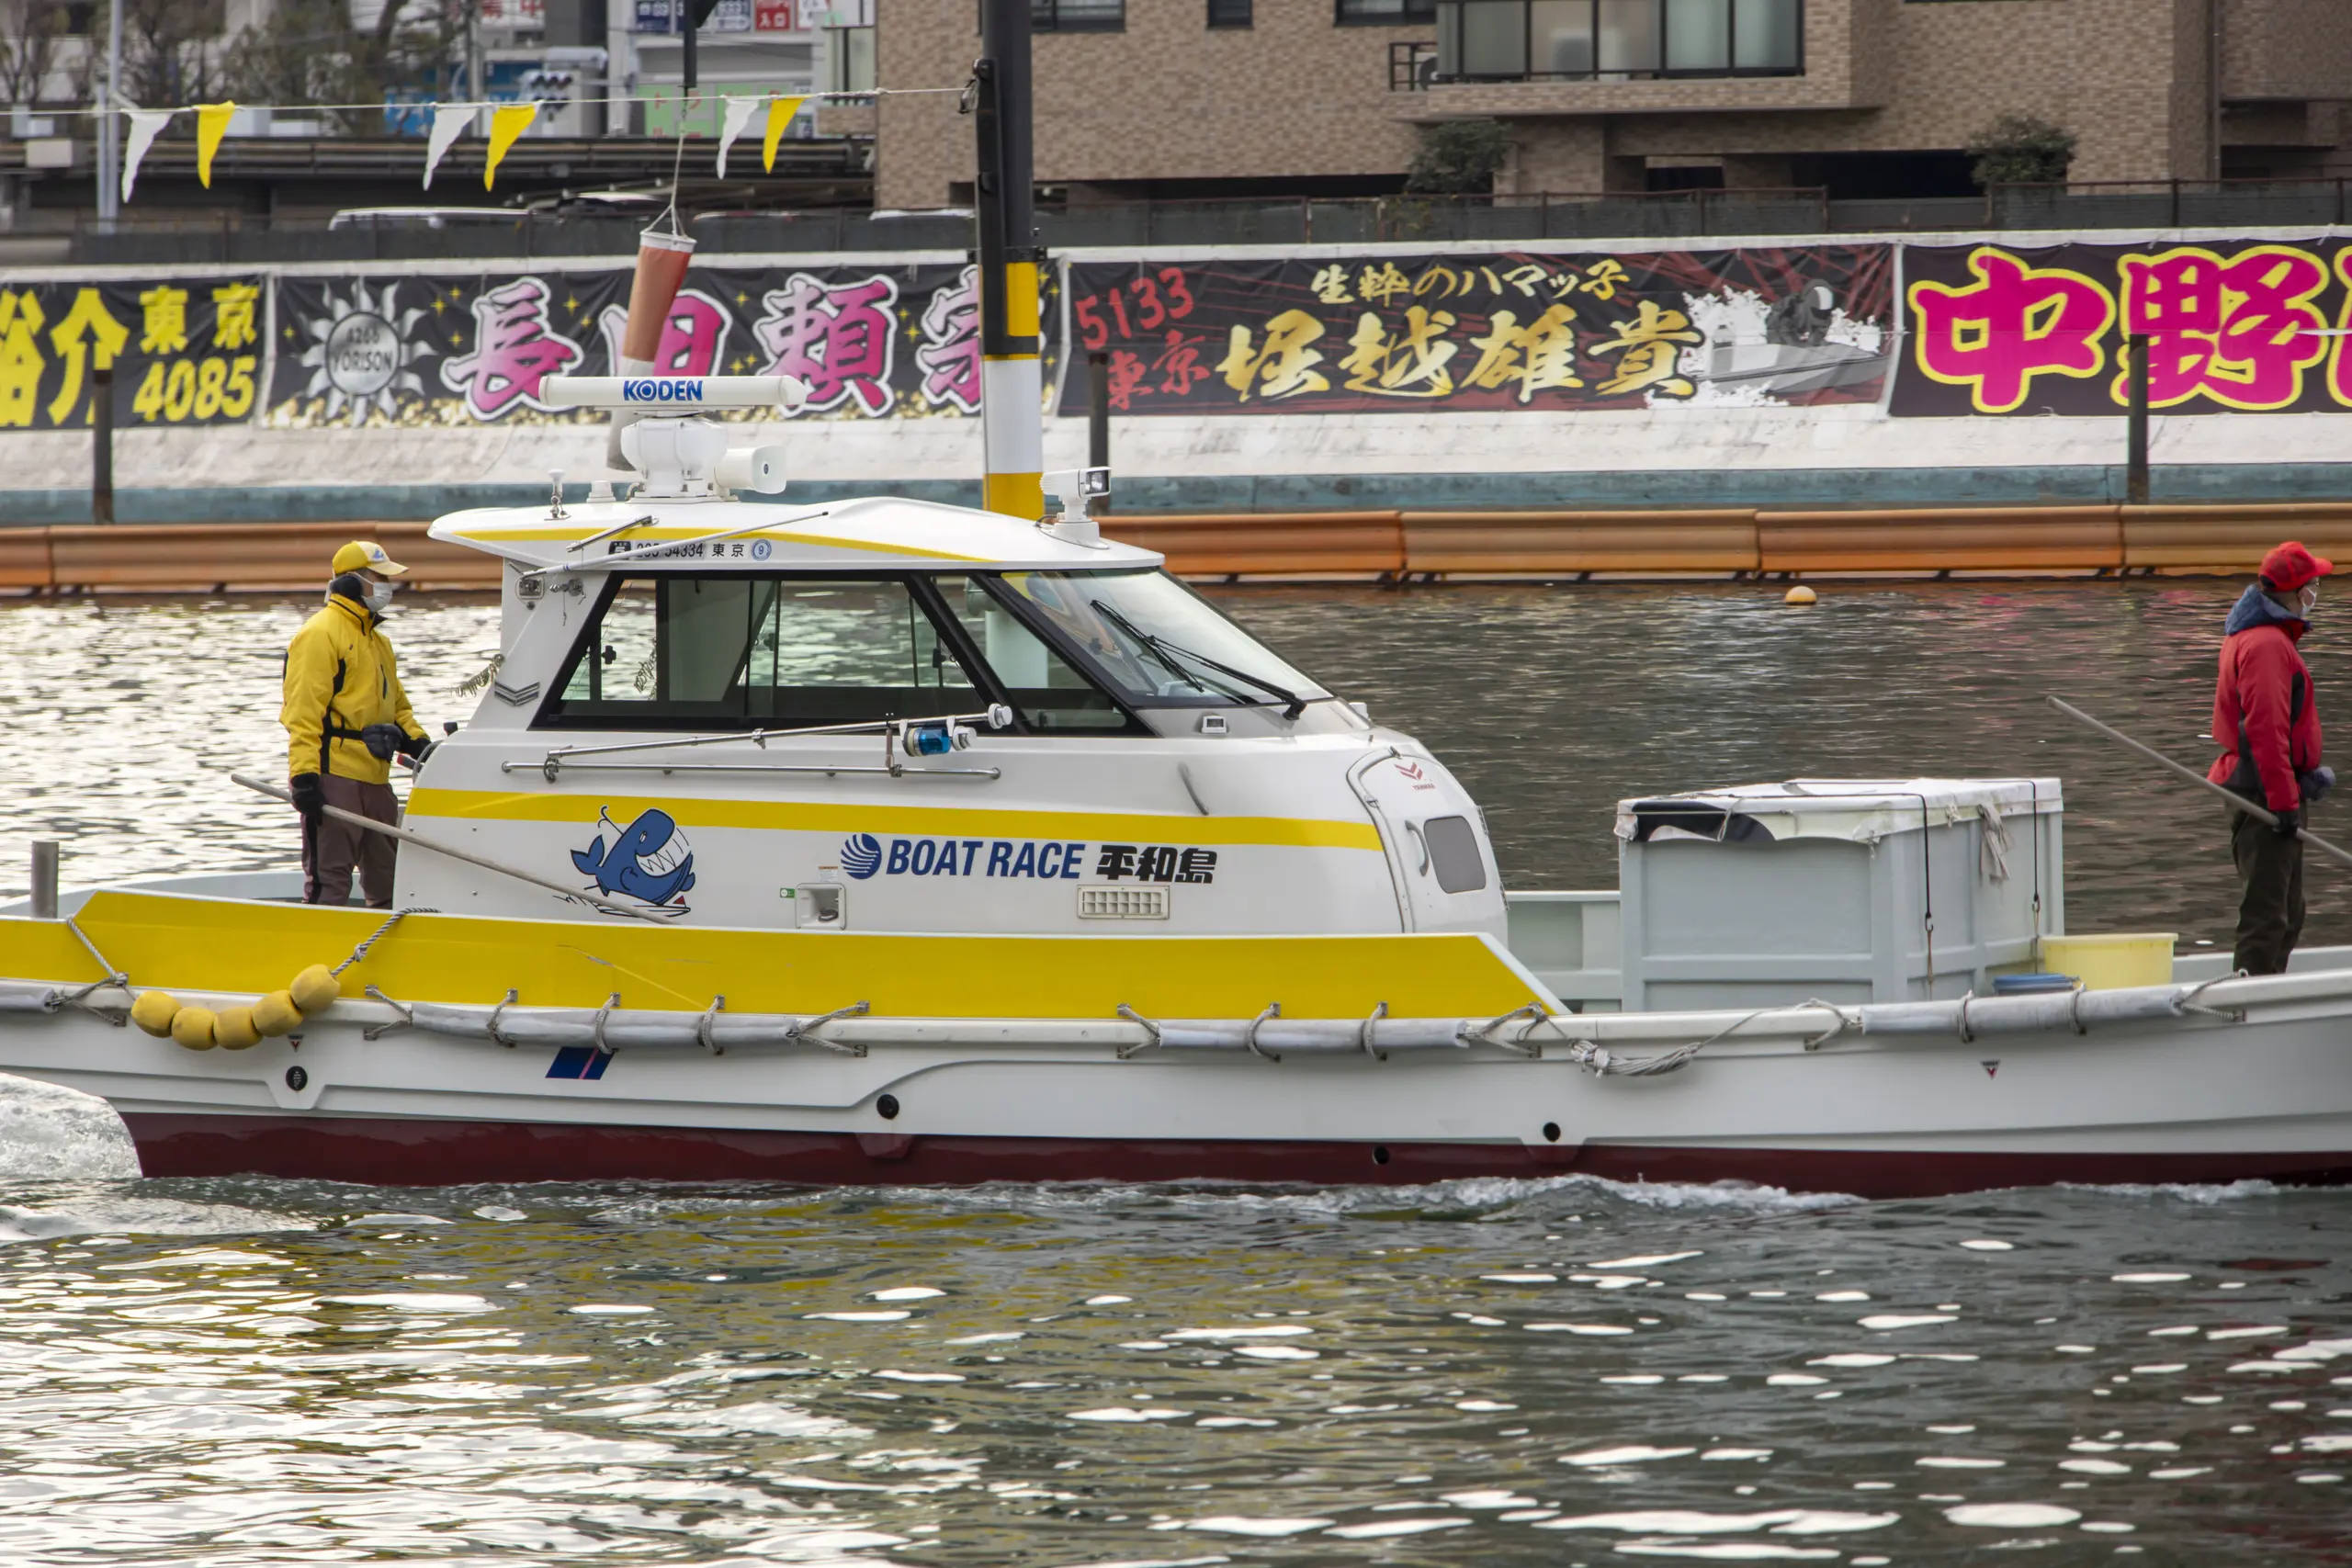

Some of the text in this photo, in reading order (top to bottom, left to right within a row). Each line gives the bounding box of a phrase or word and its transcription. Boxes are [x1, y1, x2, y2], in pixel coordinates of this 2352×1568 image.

[1075, 267, 1193, 350] 5133
[1310, 259, 1630, 308] 生粋のハマッ子
[140, 282, 259, 355] 東京
[1215, 300, 1704, 403] 堀越雄貴
[1907, 245, 2352, 413] 中野
[132, 356, 256, 422] 4085
[623, 379, 703, 401] KODEN
[1107, 331, 1208, 411] 東京
[711, 543, 745, 558] 東京
[887, 840, 1218, 884] BOAT RACE 平和島
